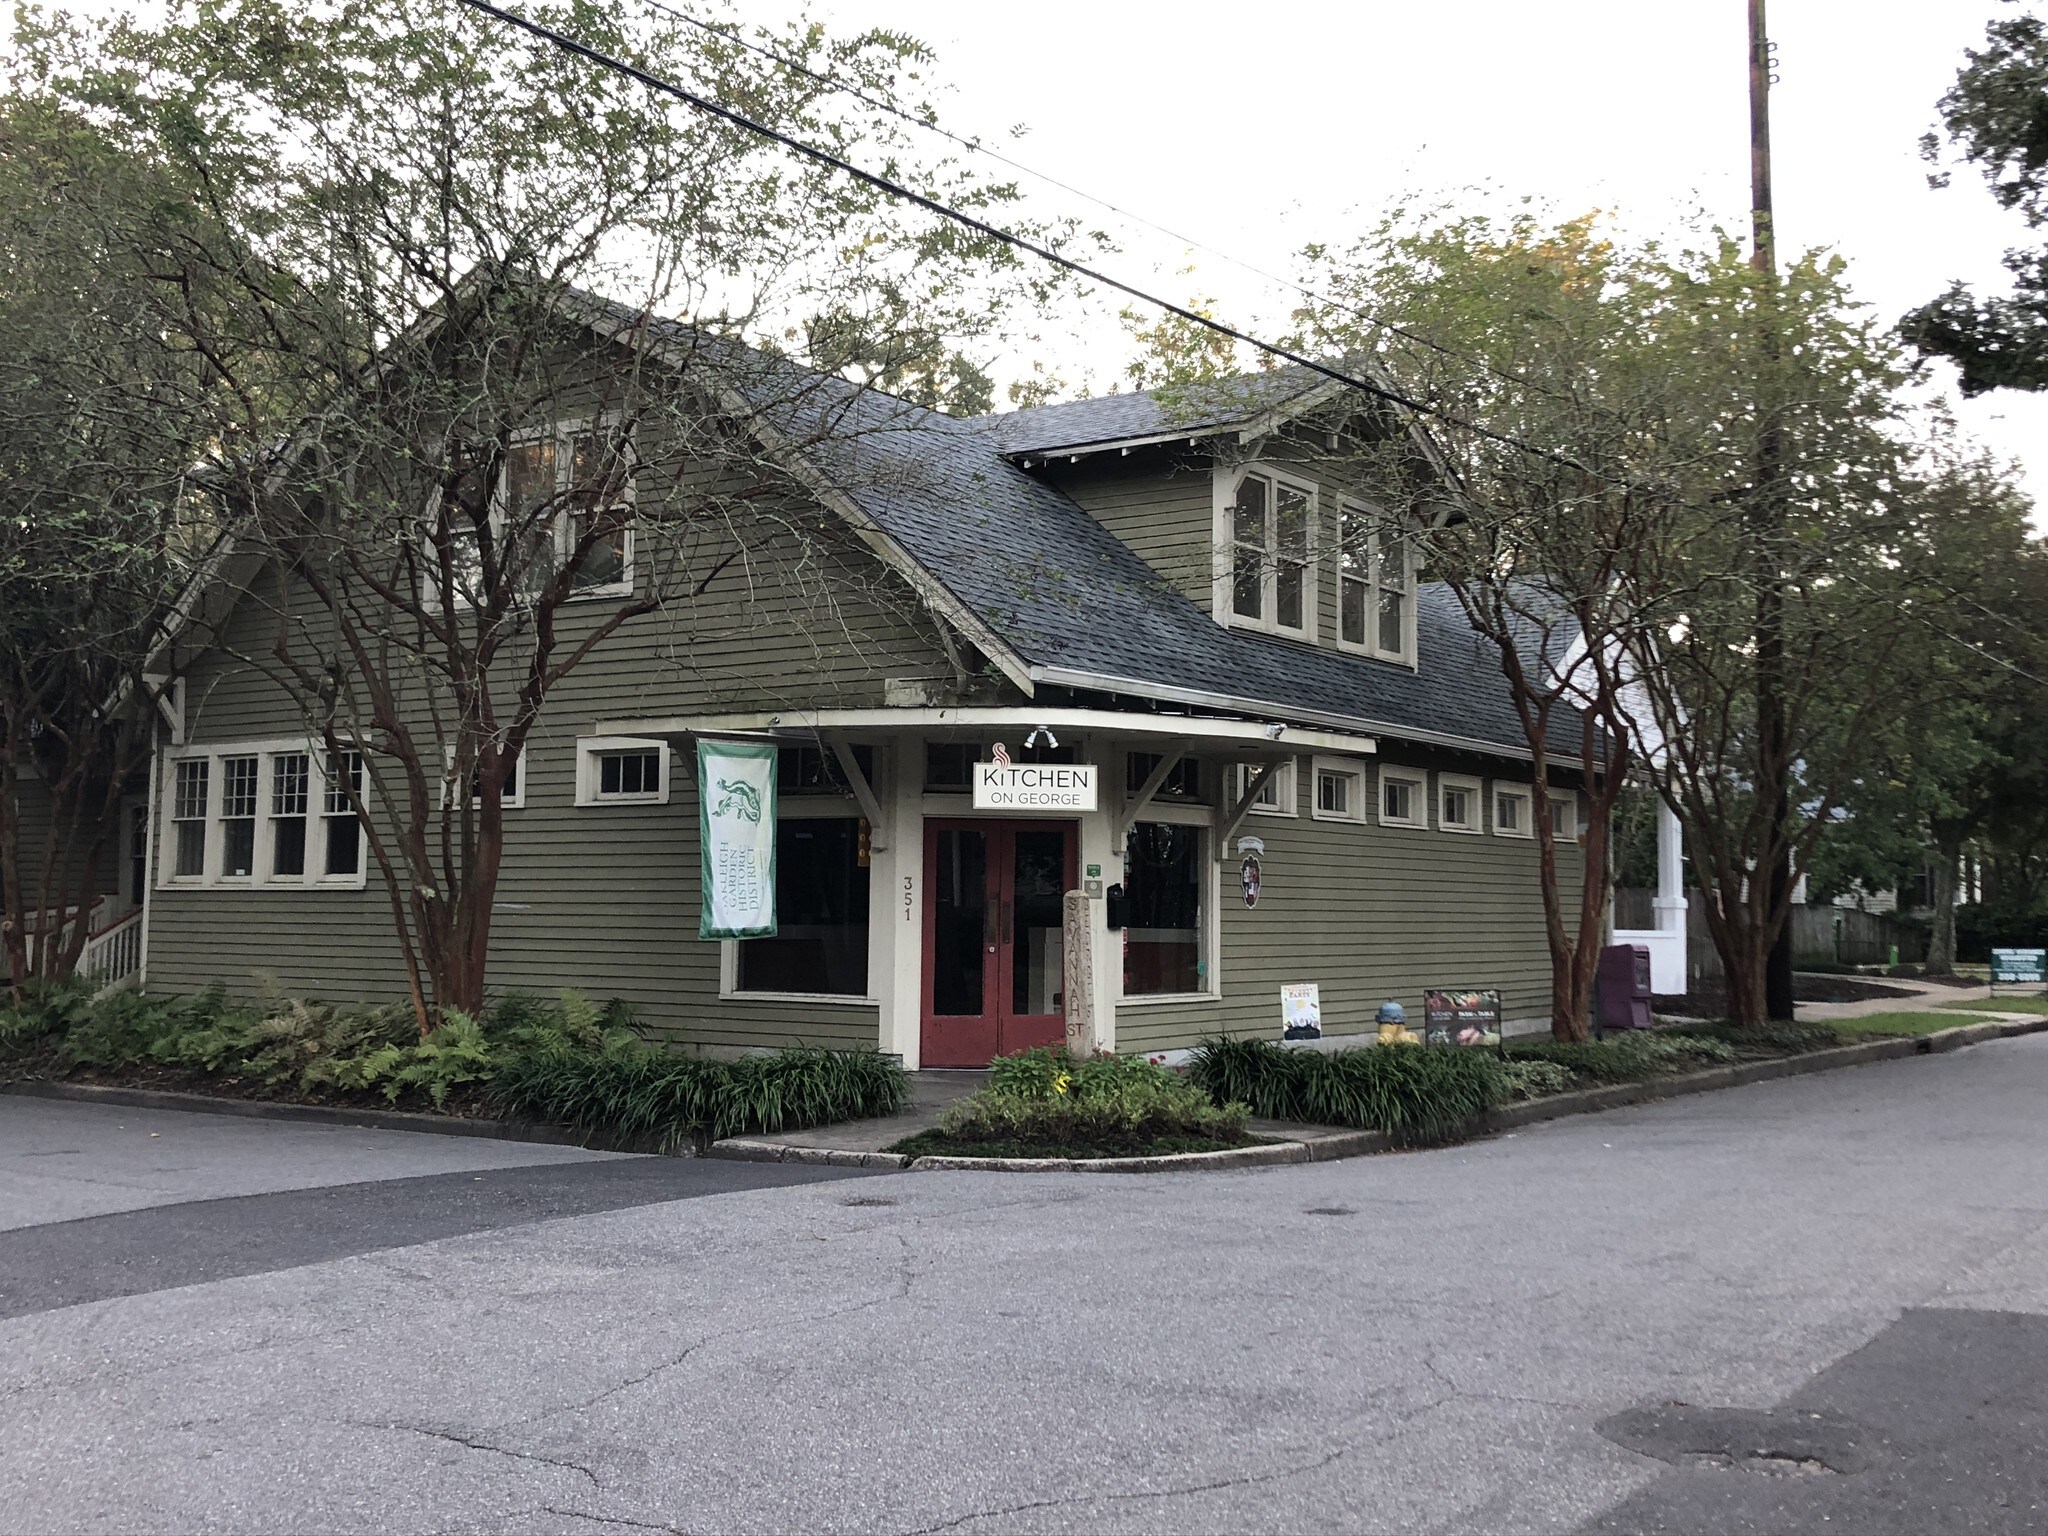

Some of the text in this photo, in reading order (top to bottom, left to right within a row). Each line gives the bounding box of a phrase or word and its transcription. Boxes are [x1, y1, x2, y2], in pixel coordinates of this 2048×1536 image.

[991, 792, 1081, 805] ON GEORGE
[728, 849, 738, 908] GARDEN
[738, 844, 748, 911] HISTORIC
[747, 846, 759, 910] DISTRICT
[903, 876, 913, 921] 351
[1066, 897, 1085, 1037] SAVANNAH ST
